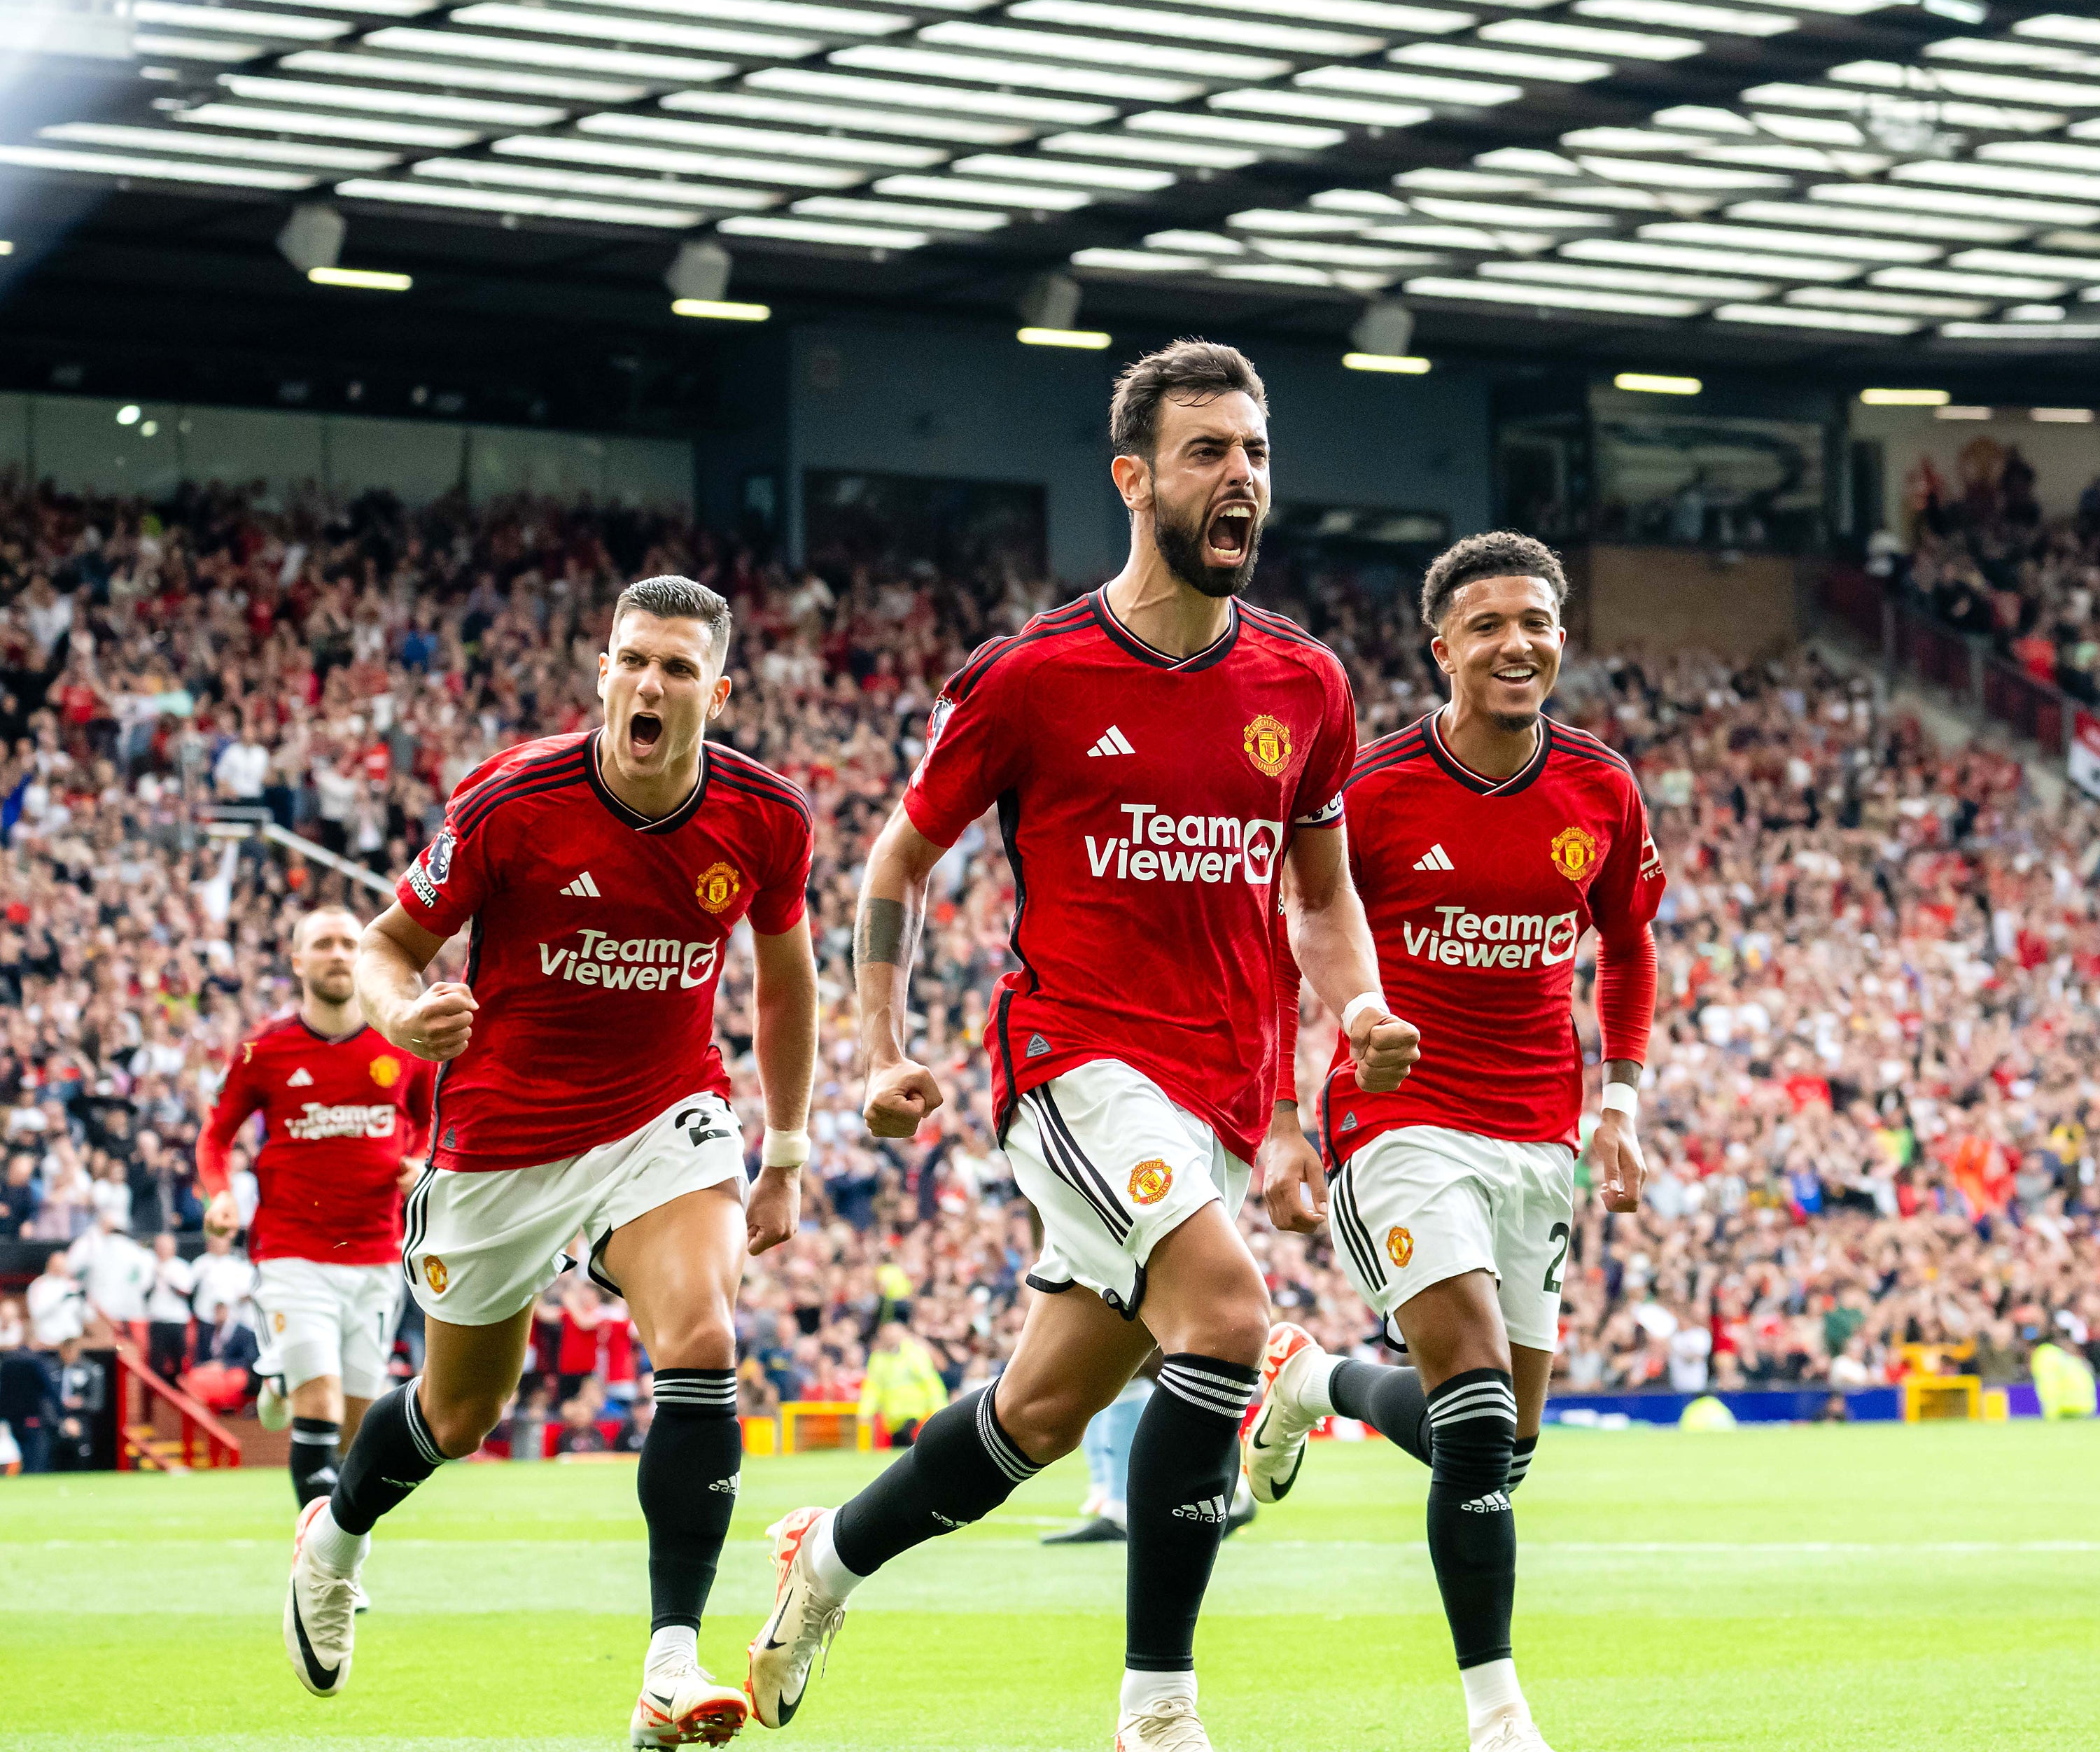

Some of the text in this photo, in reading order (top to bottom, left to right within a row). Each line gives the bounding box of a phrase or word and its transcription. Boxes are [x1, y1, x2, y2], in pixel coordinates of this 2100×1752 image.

[1247, 720, 1287, 739] MANCHESTER
[1258, 762, 1283, 772] UNITED
[1121, 804, 1240, 848] Team
[1085, 835, 1241, 883] Viewer
[1435, 906, 1544, 940] Team
[577, 929, 680, 962] Team
[1404, 920, 1540, 968] Viewer
[539, 943, 678, 990] Viewer
[1130, 1162, 1161, 1191] MANCHESTER
[1148, 1182, 1170, 1203] UNITED
[1172, 1508, 1228, 1523] adidas
[1460, 1502, 1511, 1513] adidas
